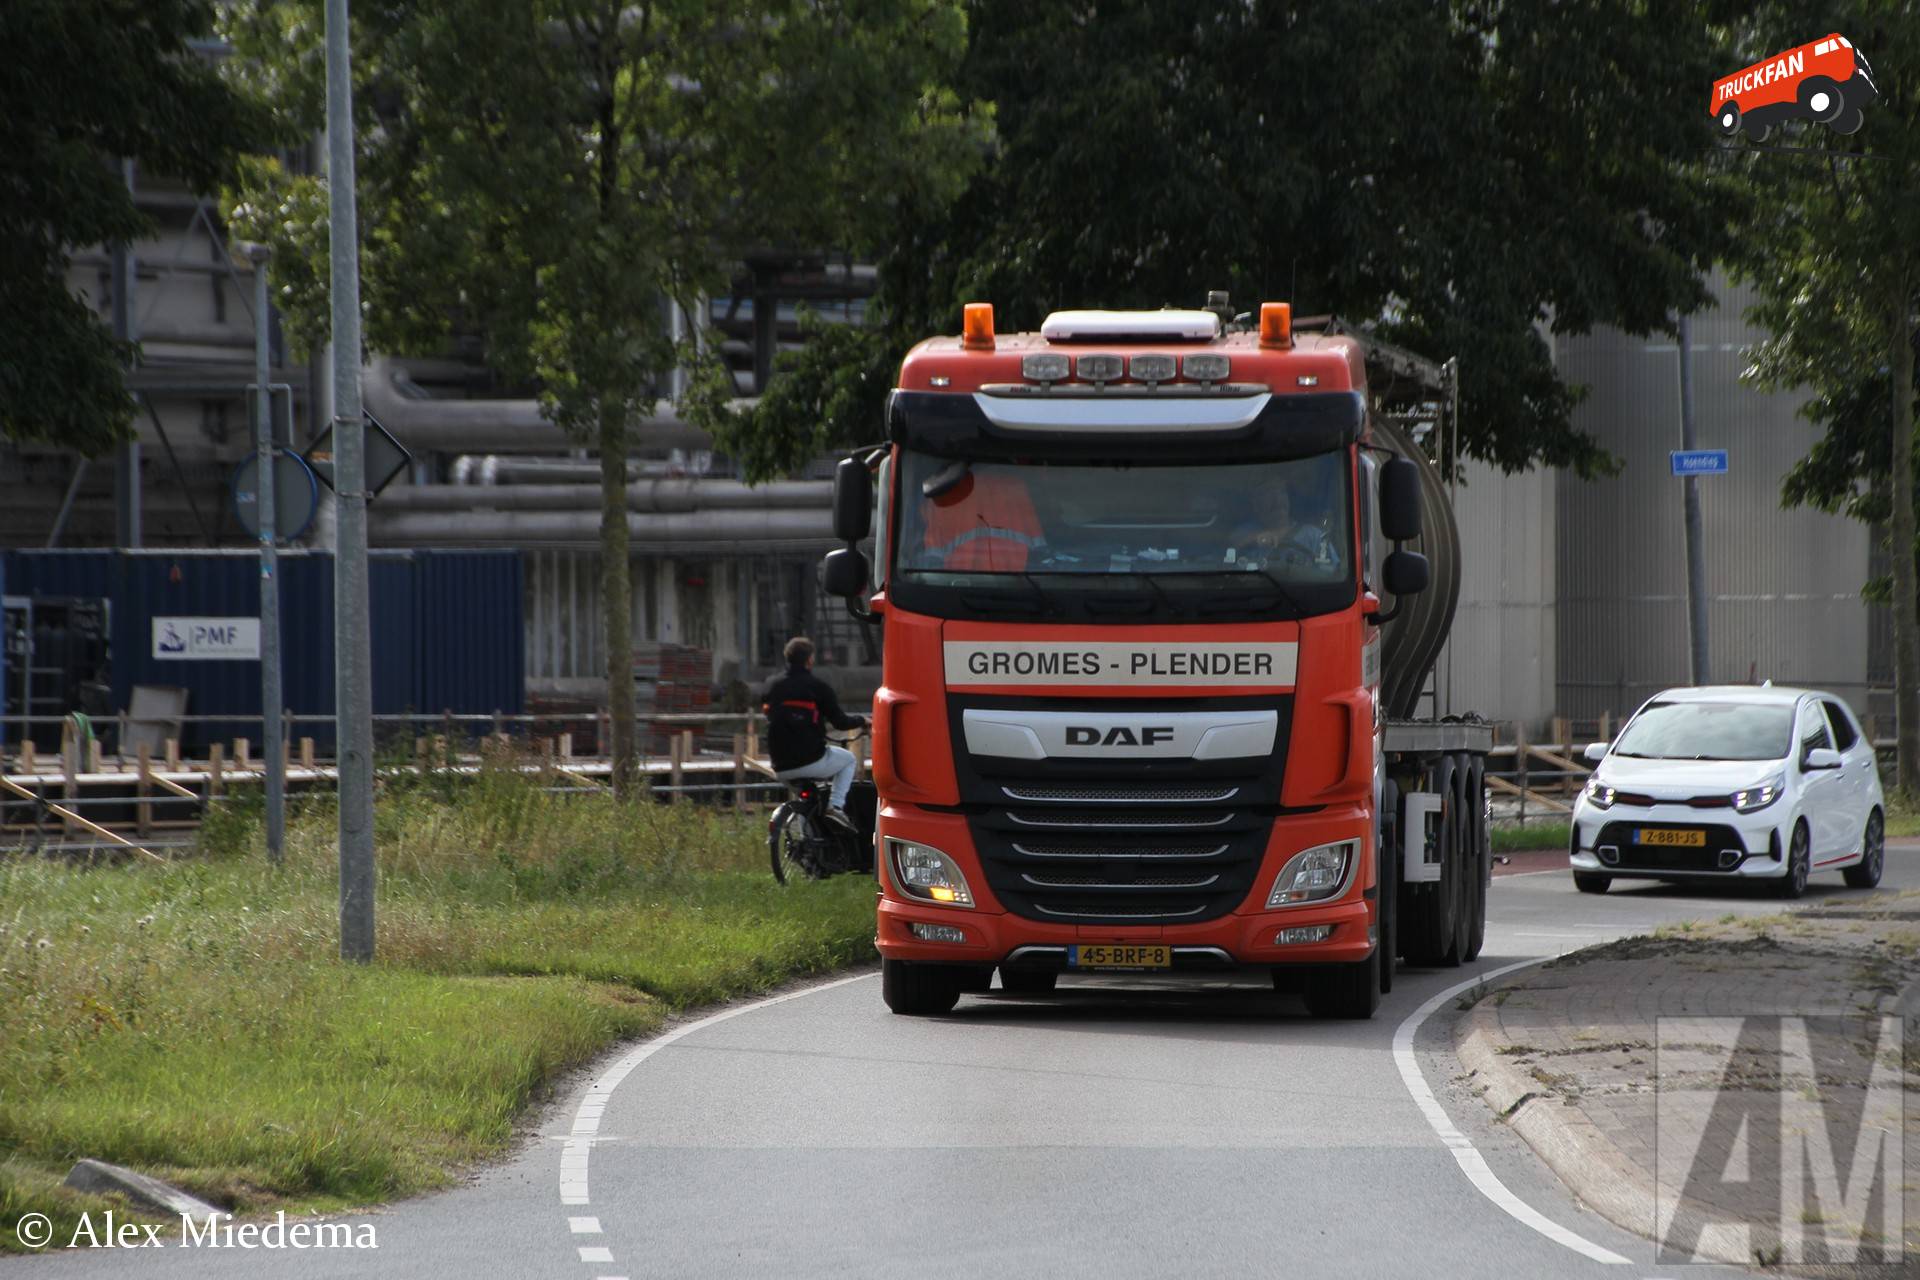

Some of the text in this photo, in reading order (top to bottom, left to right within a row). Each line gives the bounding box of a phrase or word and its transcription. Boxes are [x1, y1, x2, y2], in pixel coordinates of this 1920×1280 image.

[195, 625, 237, 645] PMF
[968, 652, 1100, 675] GROMES
[1131, 653, 1273, 675] PLENDER
[1065, 726, 1174, 746] DAF
[1646, 831, 1699, 844] Z-881-JS
[1083, 948, 1164, 964] 45-BRF-8
